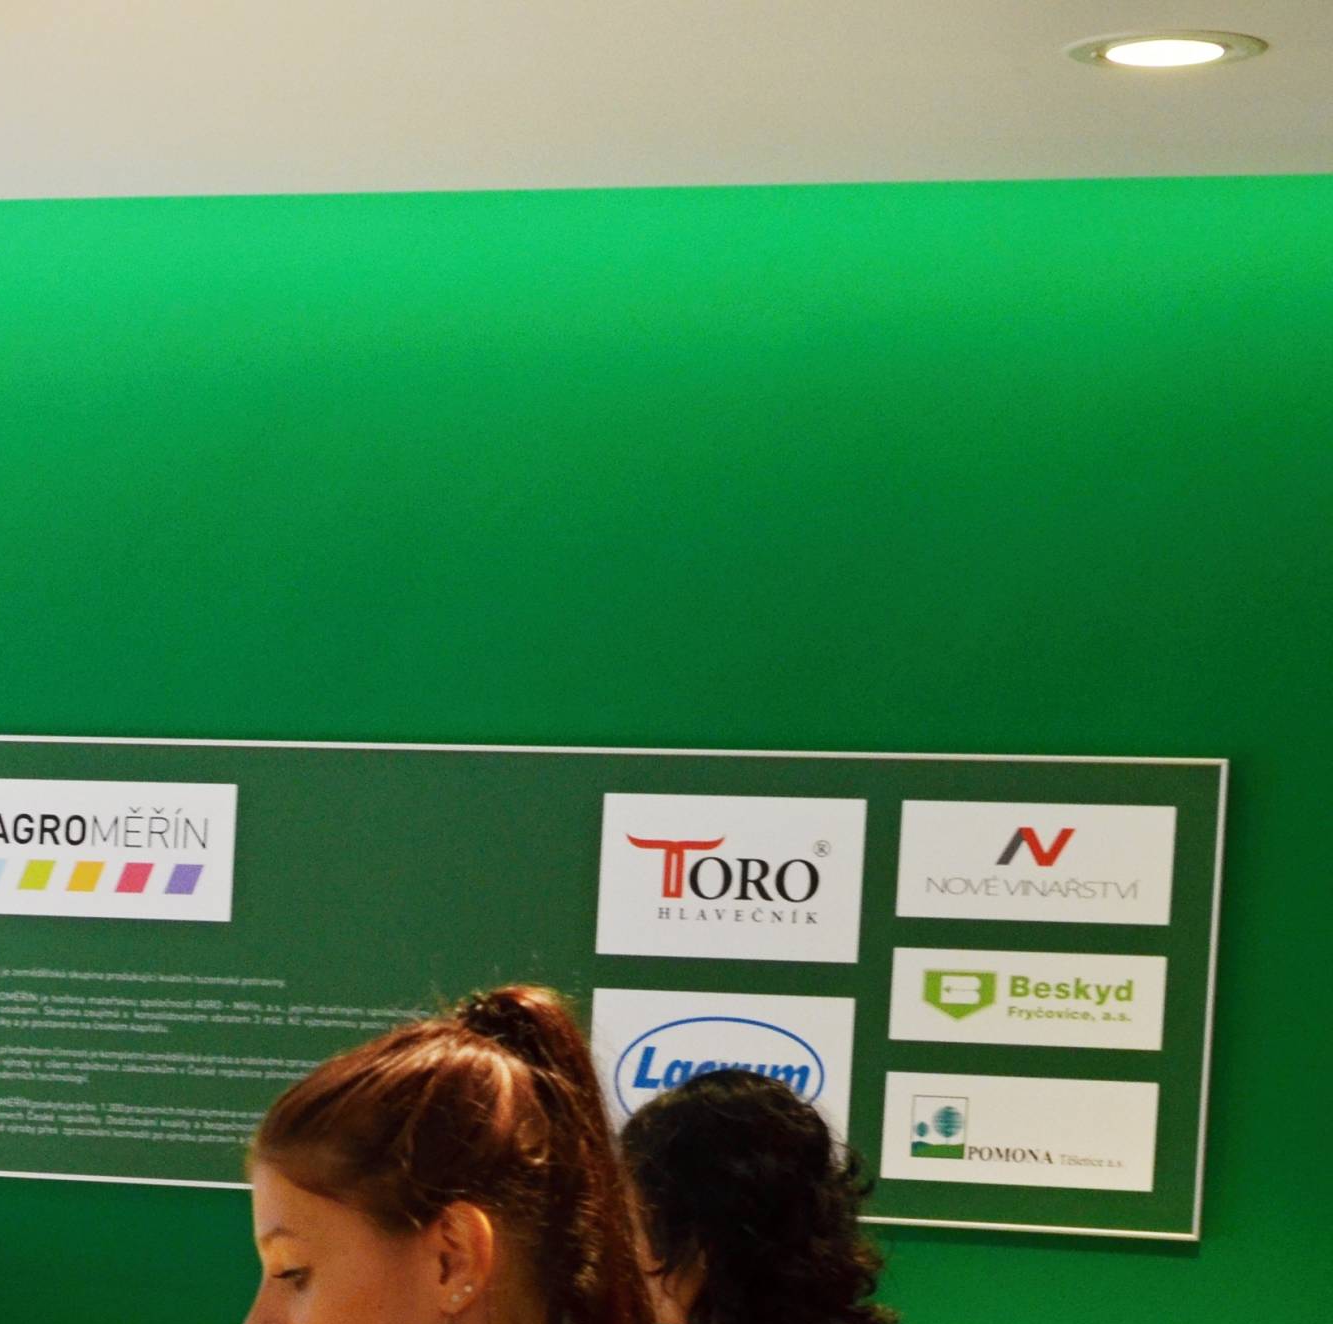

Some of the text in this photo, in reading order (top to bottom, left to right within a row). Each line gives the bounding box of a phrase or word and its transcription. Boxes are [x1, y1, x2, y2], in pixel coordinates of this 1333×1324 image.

[626, 832, 820, 903] TORO
[925, 876, 1141, 900] NOVÉ VINAŘSTVÍ
[657, 906, 819, 925] HLAVEČNÍK
[1009, 975, 1135, 1005] Beskyd
[968, 1146, 1054, 1165] POMONA
